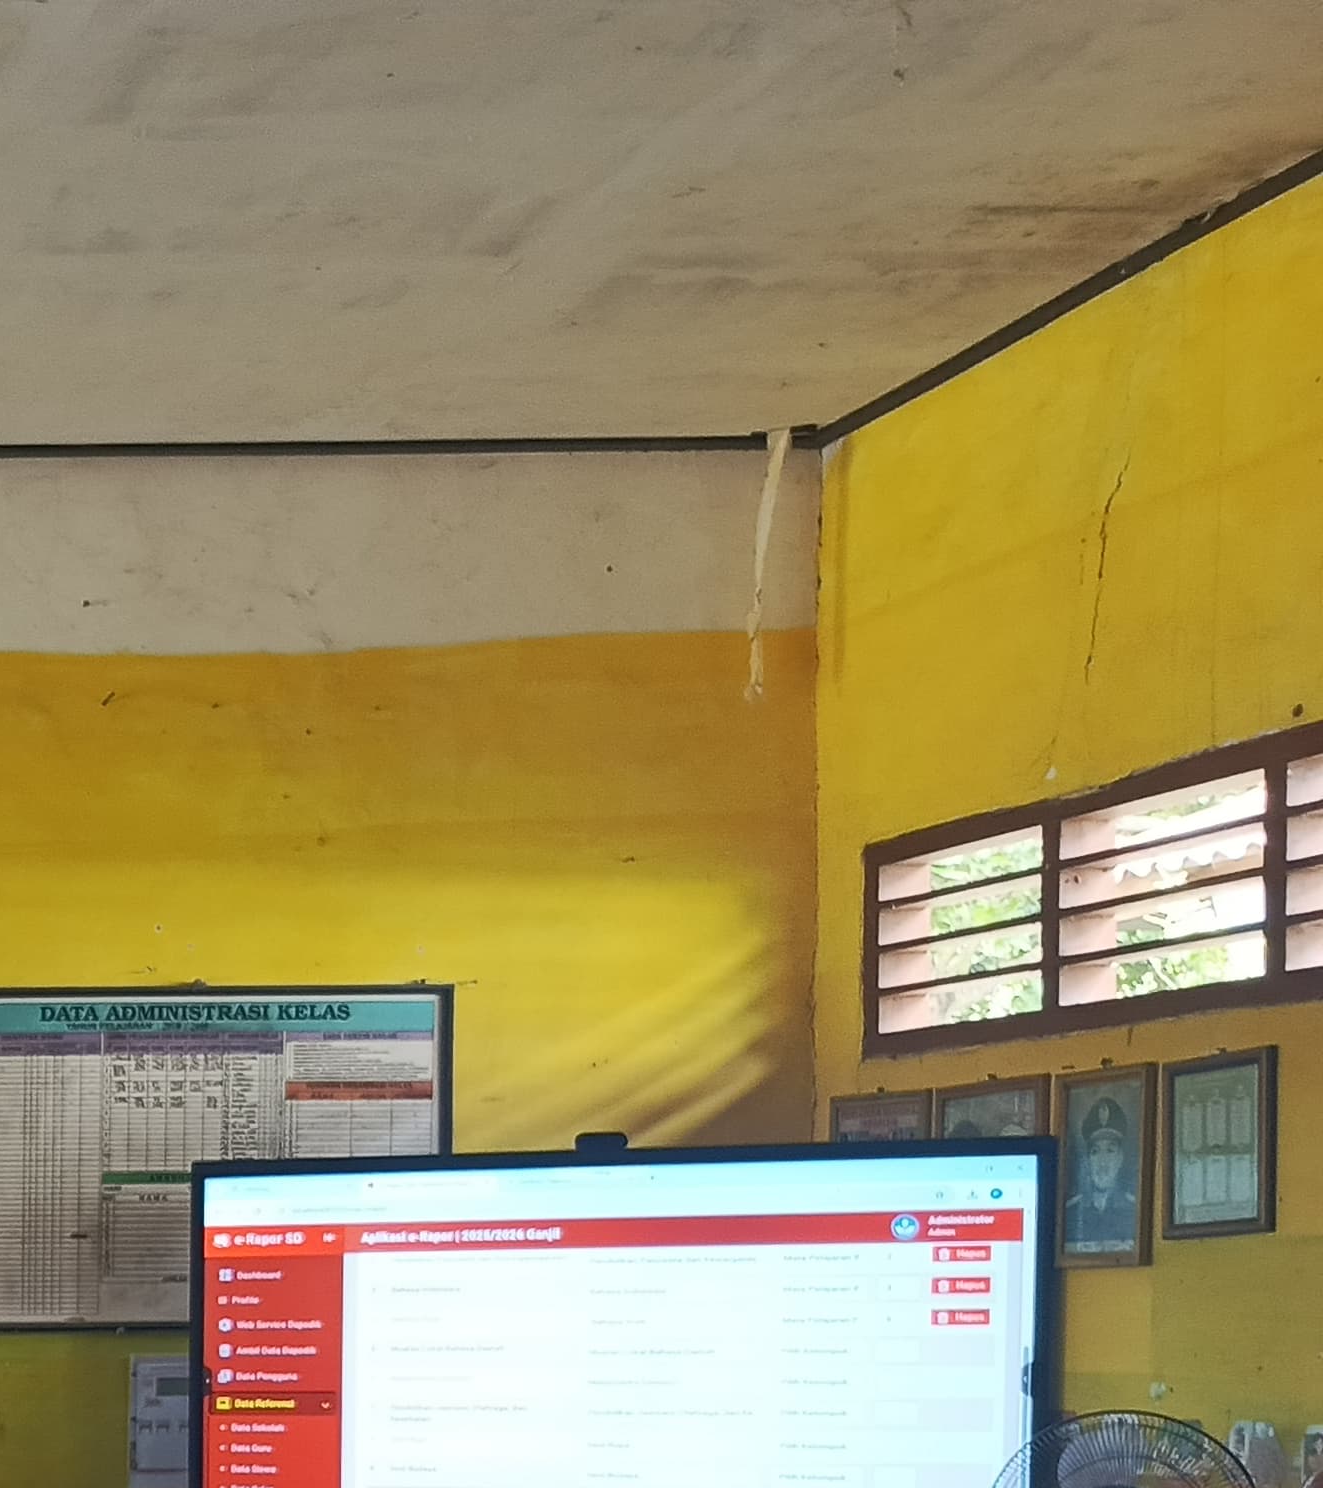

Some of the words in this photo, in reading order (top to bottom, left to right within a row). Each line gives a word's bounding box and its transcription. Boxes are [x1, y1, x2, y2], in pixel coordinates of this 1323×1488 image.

[39, 1005, 100, 1022] DATA
[105, 1004, 274, 1022] ADMINISTRASI
[277, 1003, 351, 1021] KELAS
[928, 1214, 994, 1226] Administrator
[360, 1230, 407, 1245] Aplikasi
[261, 1345, 281, 1355] Data
[235, 1371, 255, 1381] Data
[234, 1398, 254, 1409] Data
[230, 1423, 251, 1433] Data
[251, 1423, 285, 1433] Sekolah
[230, 1444, 251, 1453] Data
[230, 1465, 251, 1474] Data
